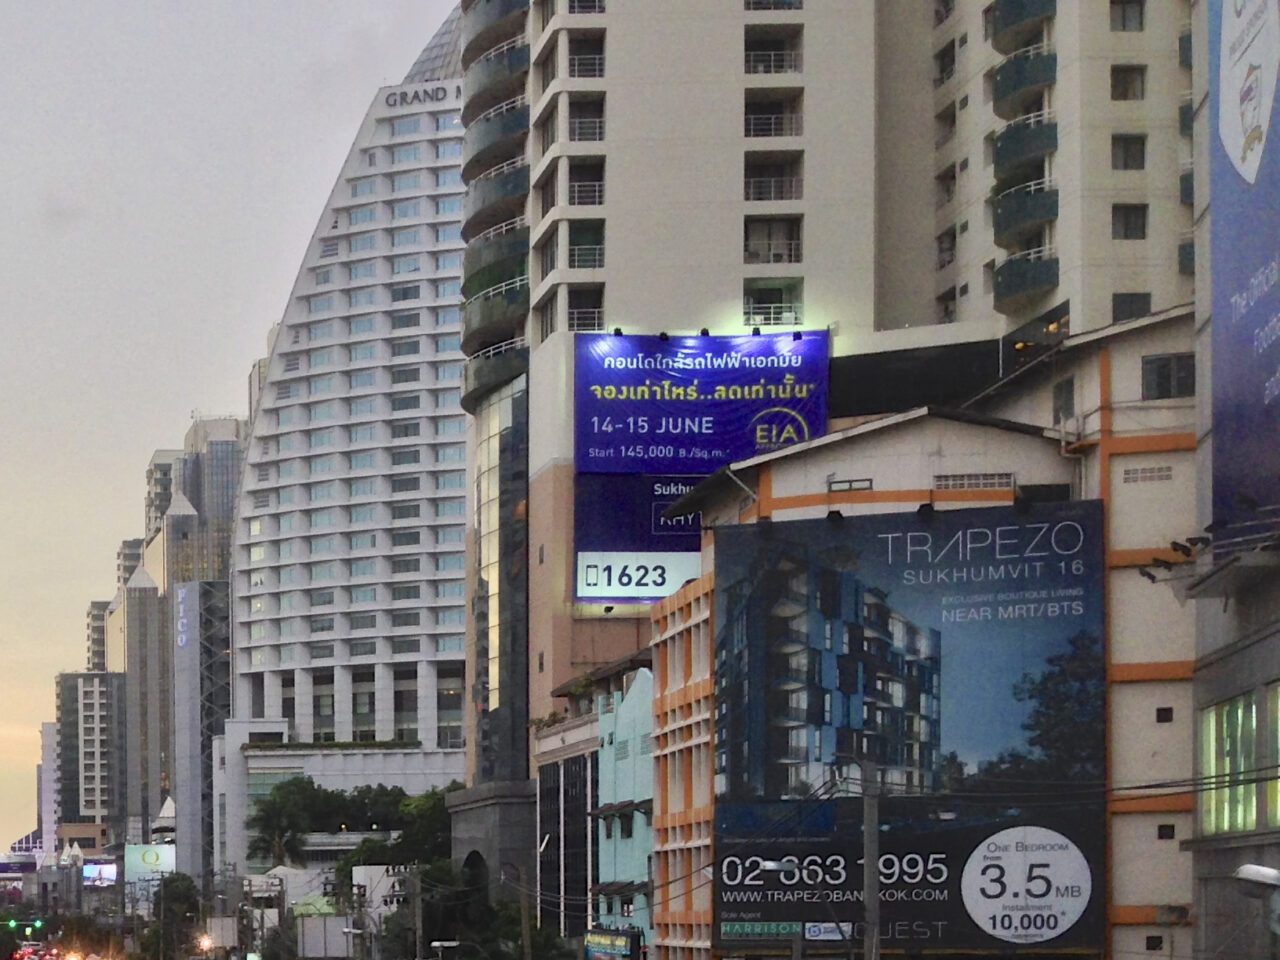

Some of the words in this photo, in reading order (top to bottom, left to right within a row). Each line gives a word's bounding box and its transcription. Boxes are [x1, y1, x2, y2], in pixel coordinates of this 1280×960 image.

[385, 87, 447, 108] GRAND
[591, 416, 649, 433] 14-15
[656, 416, 714, 433] JUNE
[756, 424, 799, 443] EIA
[589, 448, 614, 457] Start
[620, 446, 674, 459] 145,000
[877, 521, 1084, 565] TRAPEZO
[603, 565, 667, 587] 1623
[903, 562, 1045, 586] SUKHUMVIT
[1058, 560, 1084, 576] 16
[942, 607, 992, 623] NEAR
[998, 601, 1084, 620] MRT/BTS
[142, 849, 161, 869] Q
[856, 853, 949, 885] 995
[979, 863, 1052, 900] 3.5
[1055, 885, 1082, 898] MB
[722, 888, 949, 903] WWW.TRAPEZOBANKOK.COM
[1002, 903, 1053, 912] Installment
[722, 923, 801, 934] HARRISON
